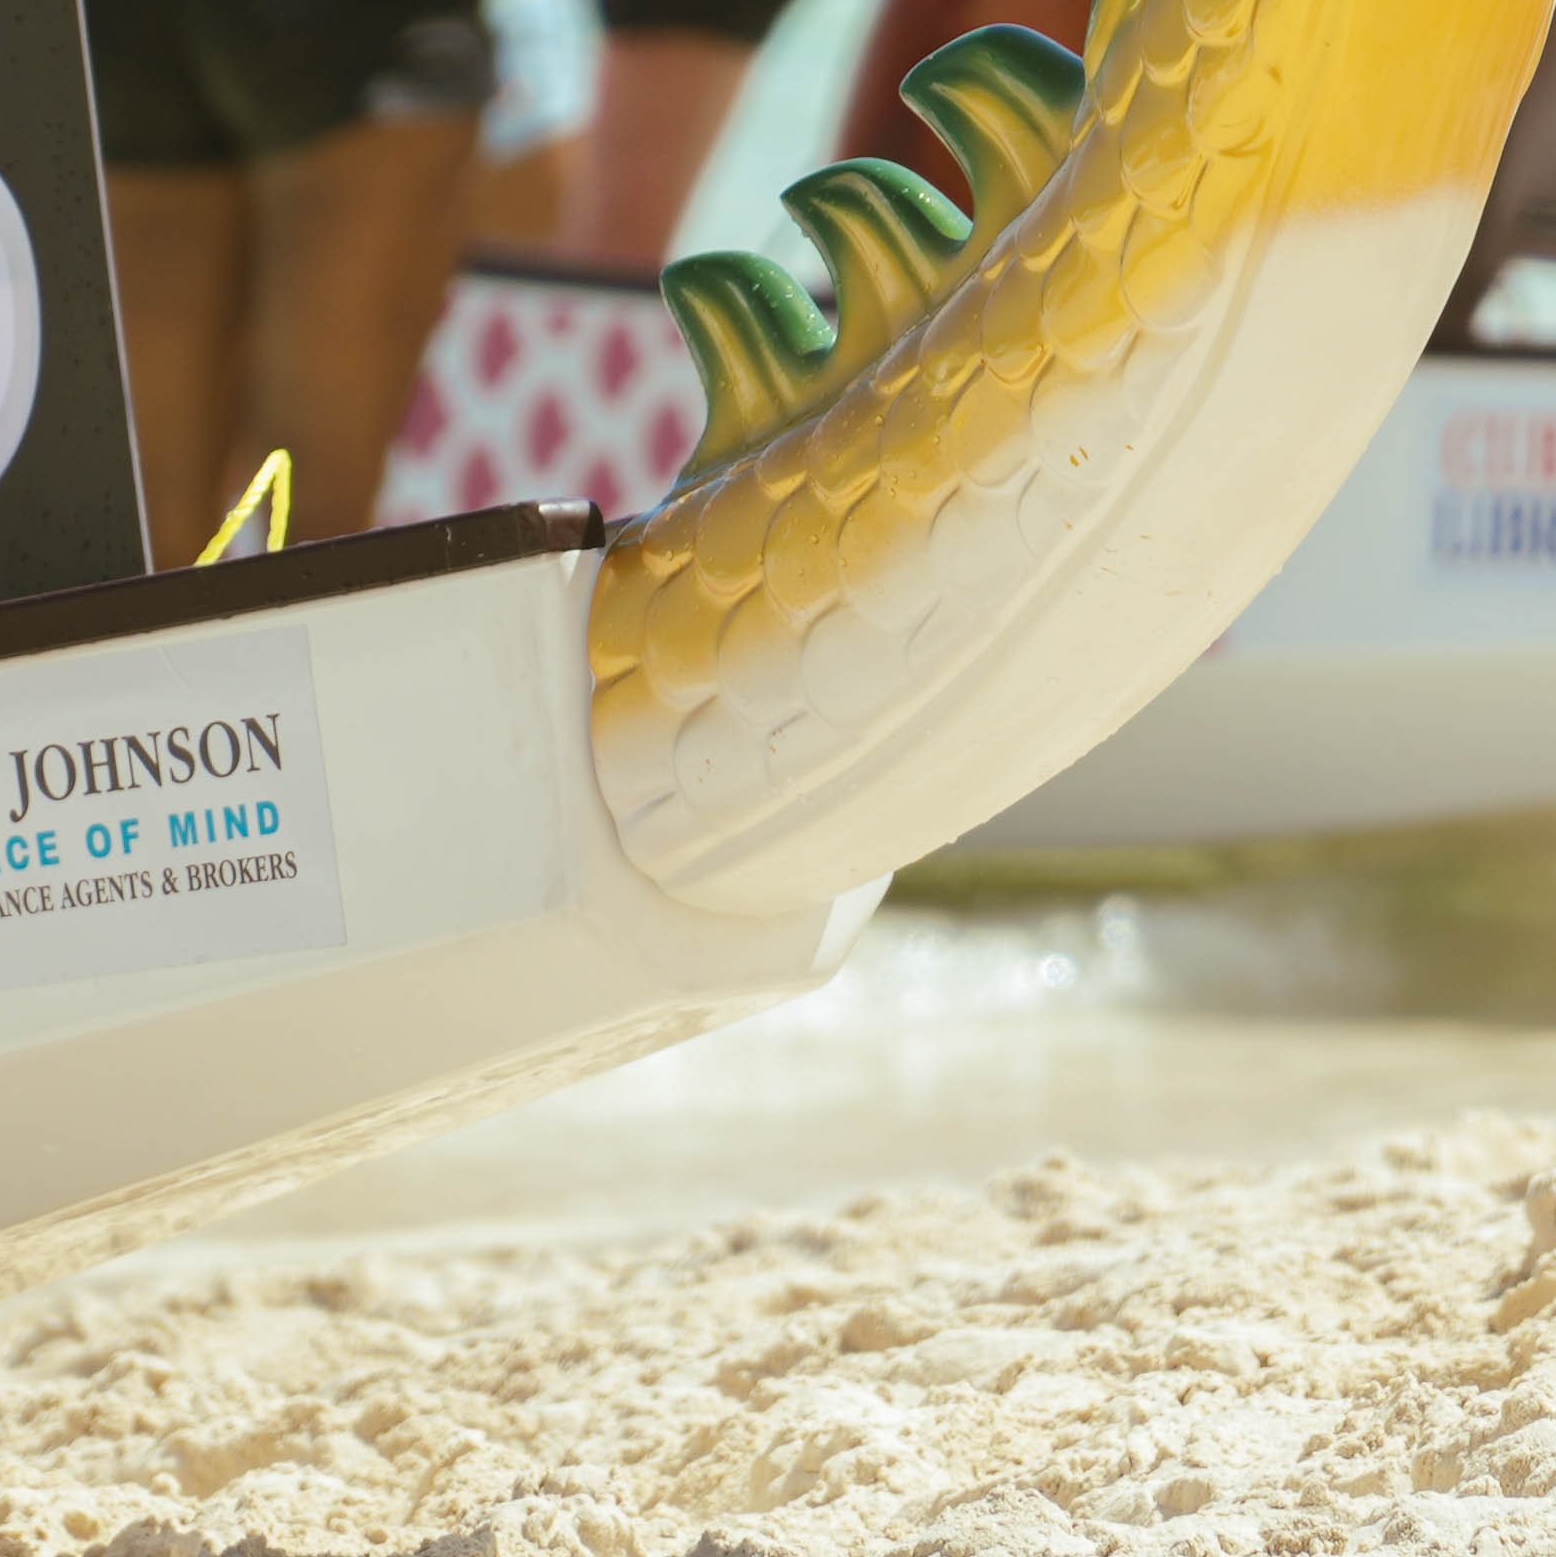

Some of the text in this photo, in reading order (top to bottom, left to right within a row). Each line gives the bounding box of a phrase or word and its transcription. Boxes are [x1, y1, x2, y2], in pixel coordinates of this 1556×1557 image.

[8, 713, 282, 823] JOHNSON
[85, 818, 140, 859] OF
[168, 800, 281, 848] MIND
[60, 870, 153, 910] AGENTS
[161, 867, 180, 895] &
[186, 851, 298, 892] BROKERS
